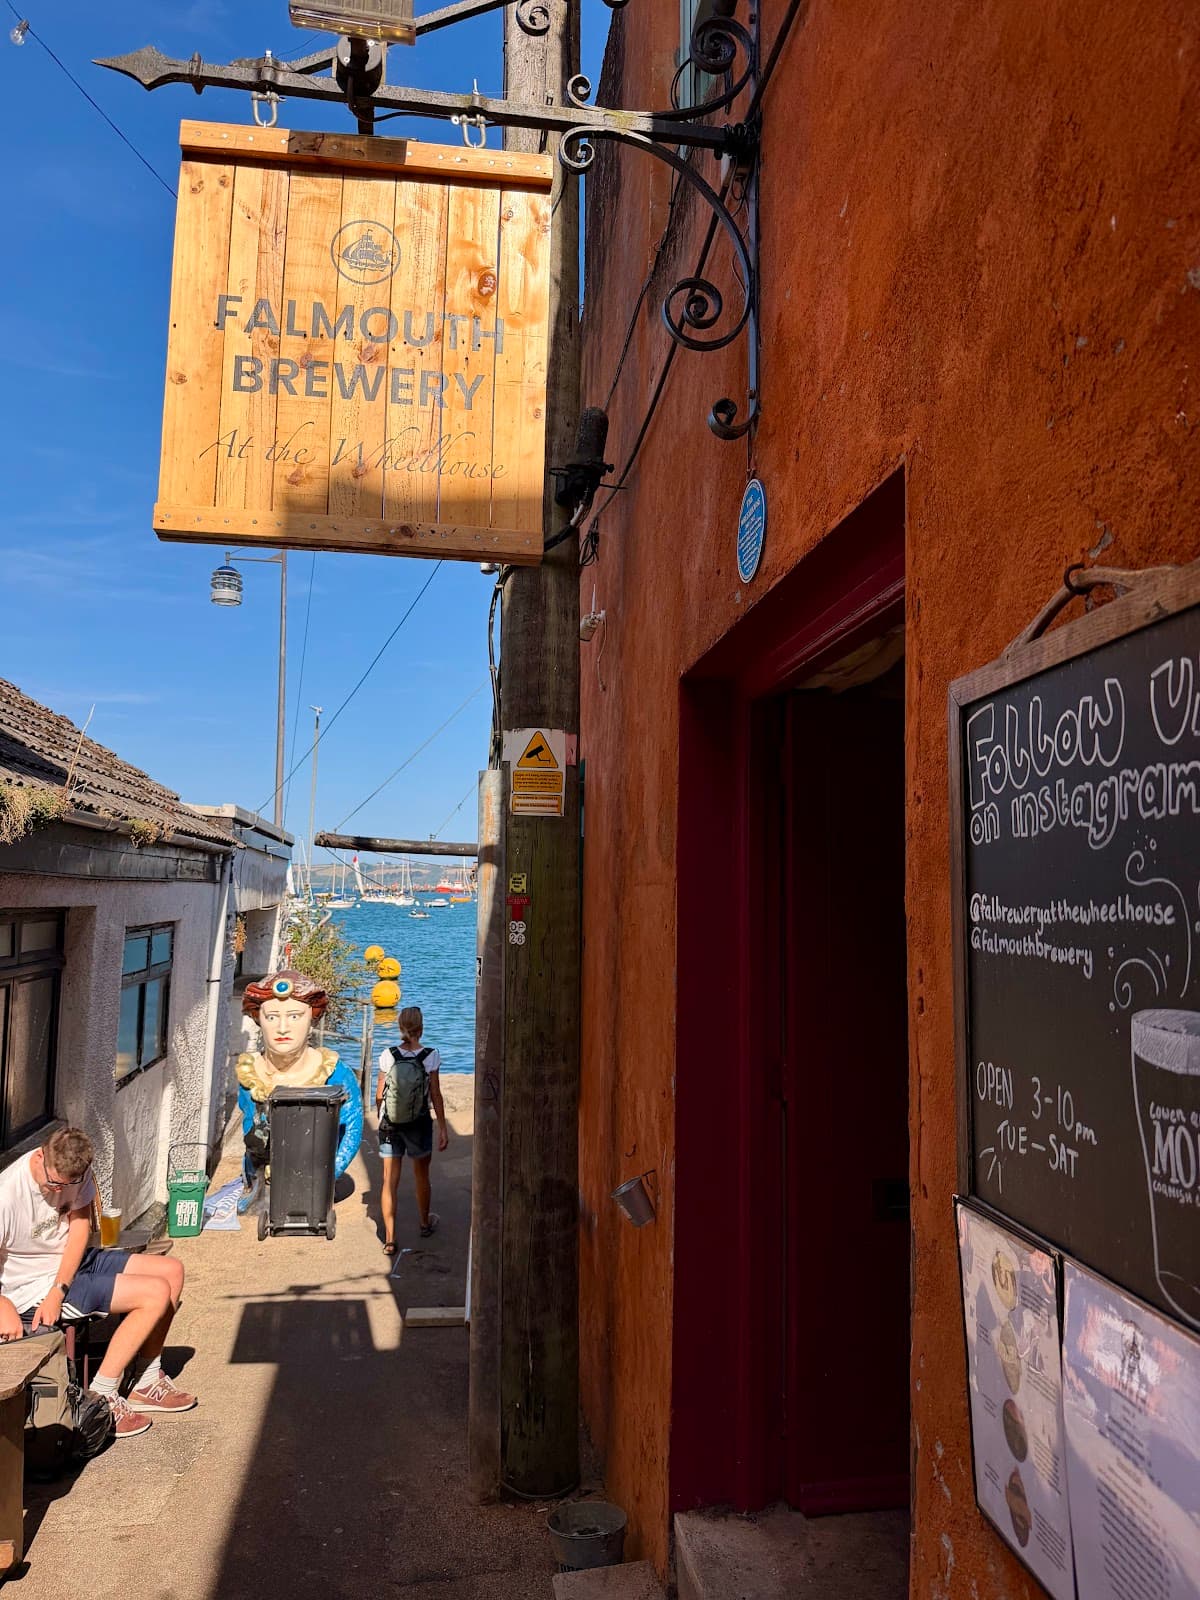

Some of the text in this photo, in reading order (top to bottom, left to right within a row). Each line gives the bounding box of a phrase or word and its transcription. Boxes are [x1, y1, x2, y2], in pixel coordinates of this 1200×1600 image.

[215, 293, 505, 355] FALMOUTH
[232, 354, 485, 411] BREWERY
[199, 421, 508, 480] At the Wheelhouse
[1150, 656, 1200, 746] U
[970, 801, 1000, 846] on
[969, 892, 1176, 936] @falbreweryatthewheelhouse
[970, 926, 1094, 980] @falmouthbrewery
[976, 1061, 1014, 1112] OPEN
[1152, 1119, 1200, 1189] MO
[149, 1384, 169, 1403] N
